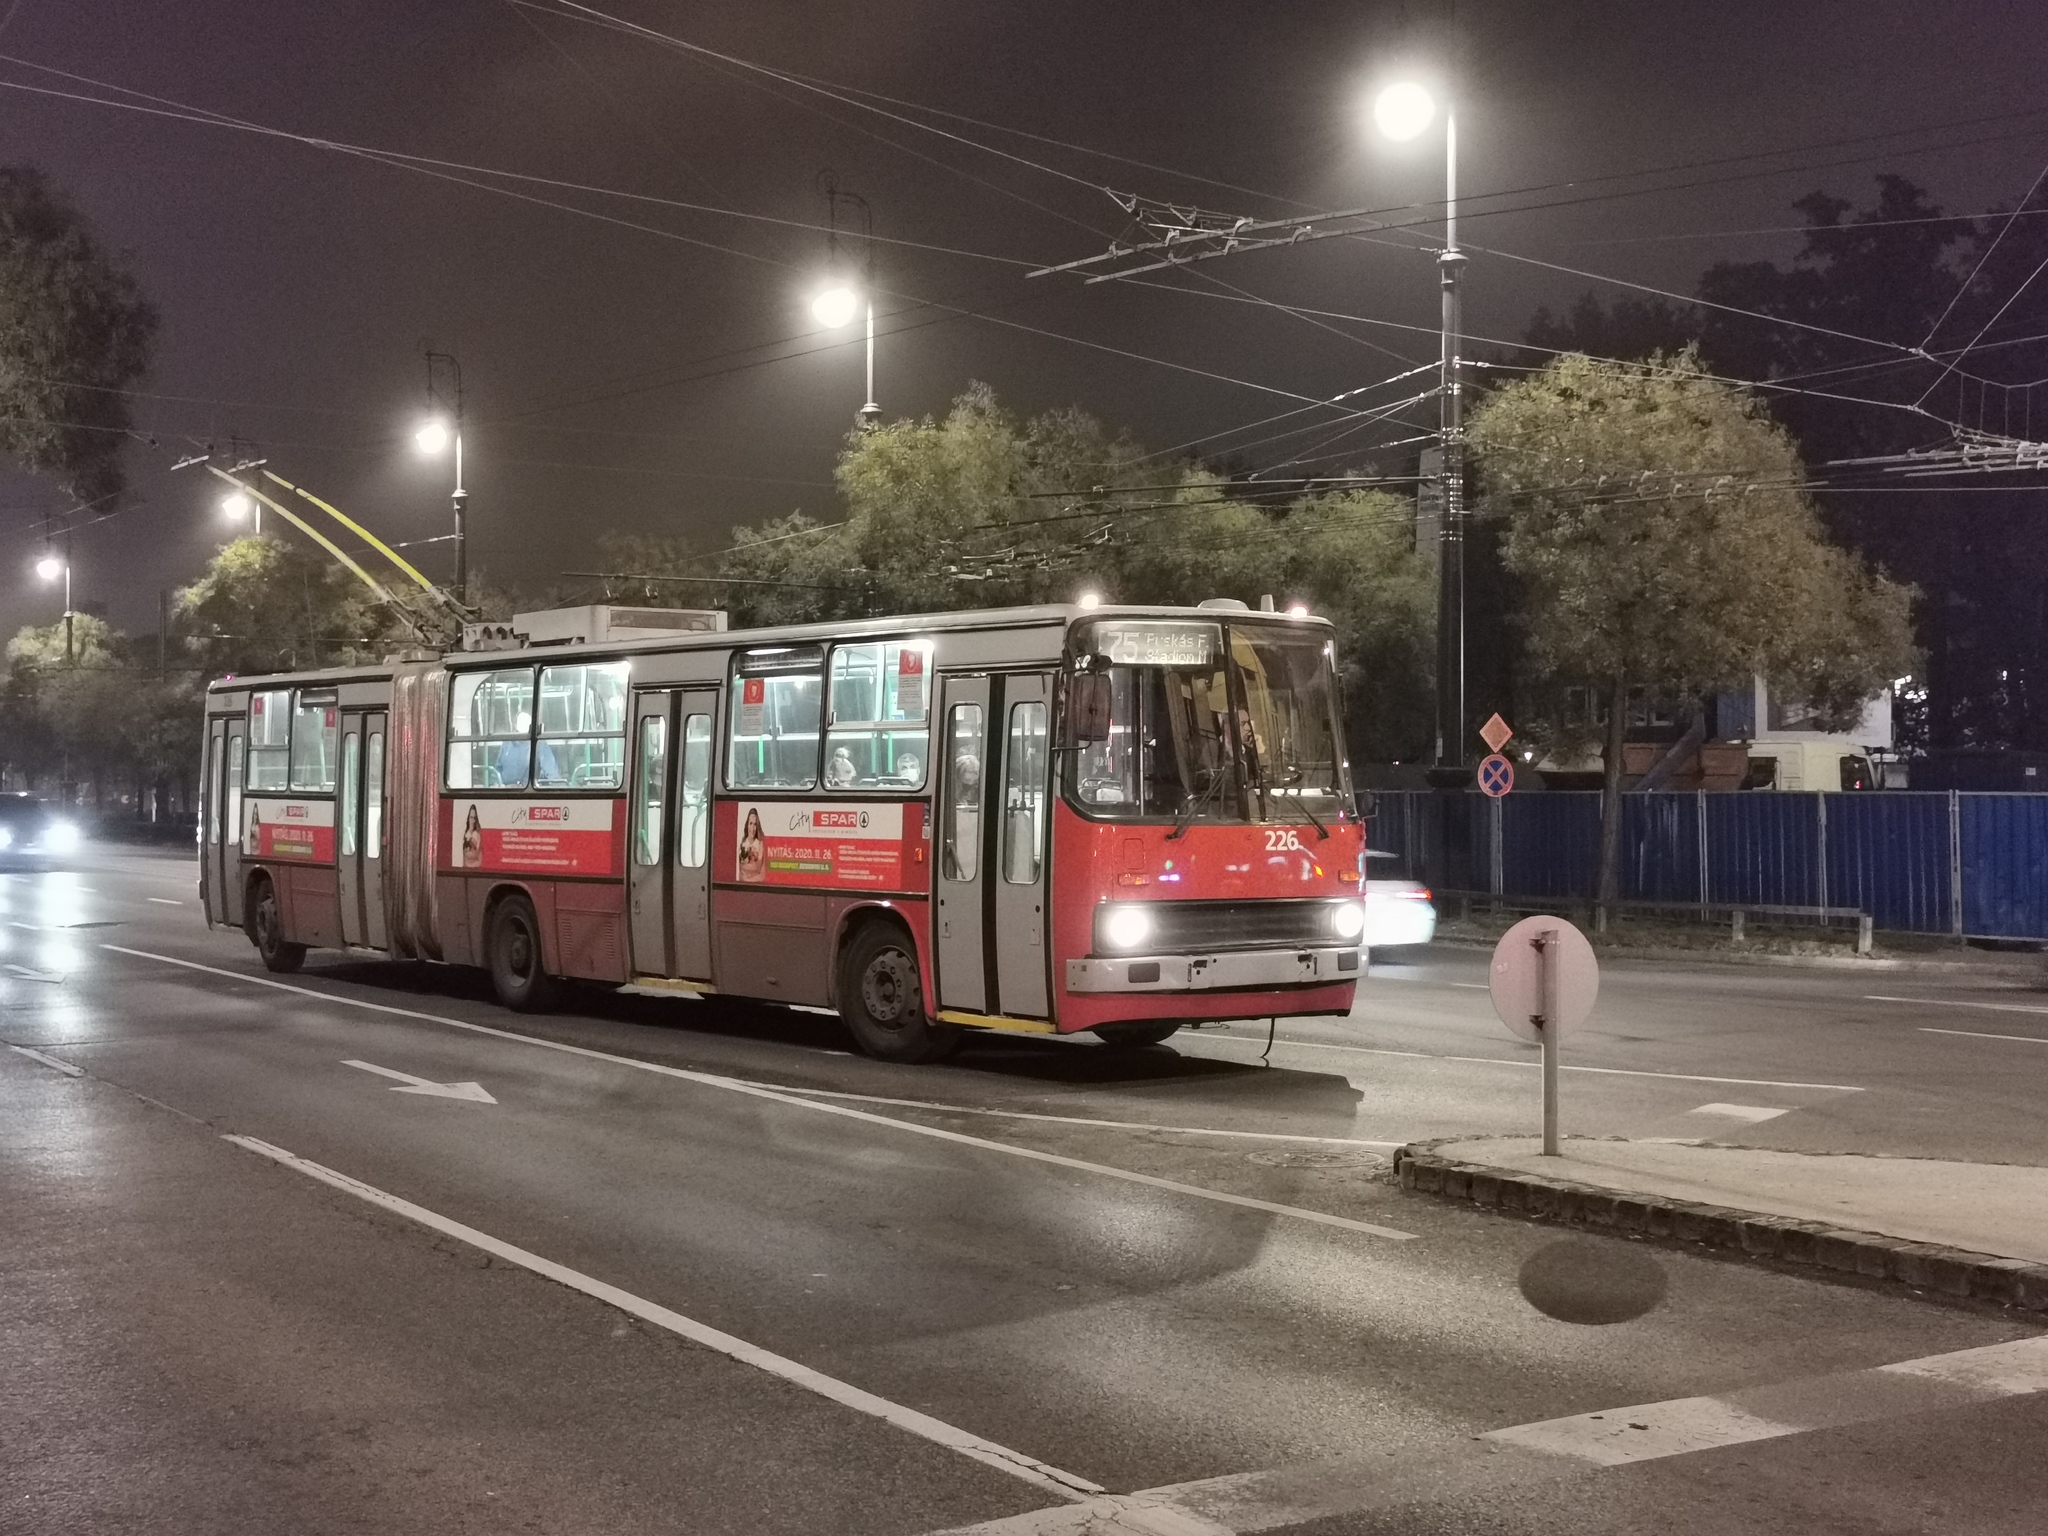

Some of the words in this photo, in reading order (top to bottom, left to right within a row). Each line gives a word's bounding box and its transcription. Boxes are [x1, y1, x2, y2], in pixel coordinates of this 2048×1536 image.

[1107, 631, 1140, 663] 75
[534, 807, 561, 820] SPAR
[789, 811, 811, 833] City
[820, 813, 857, 826] SPAR
[1264, 830, 1299, 851] 226
